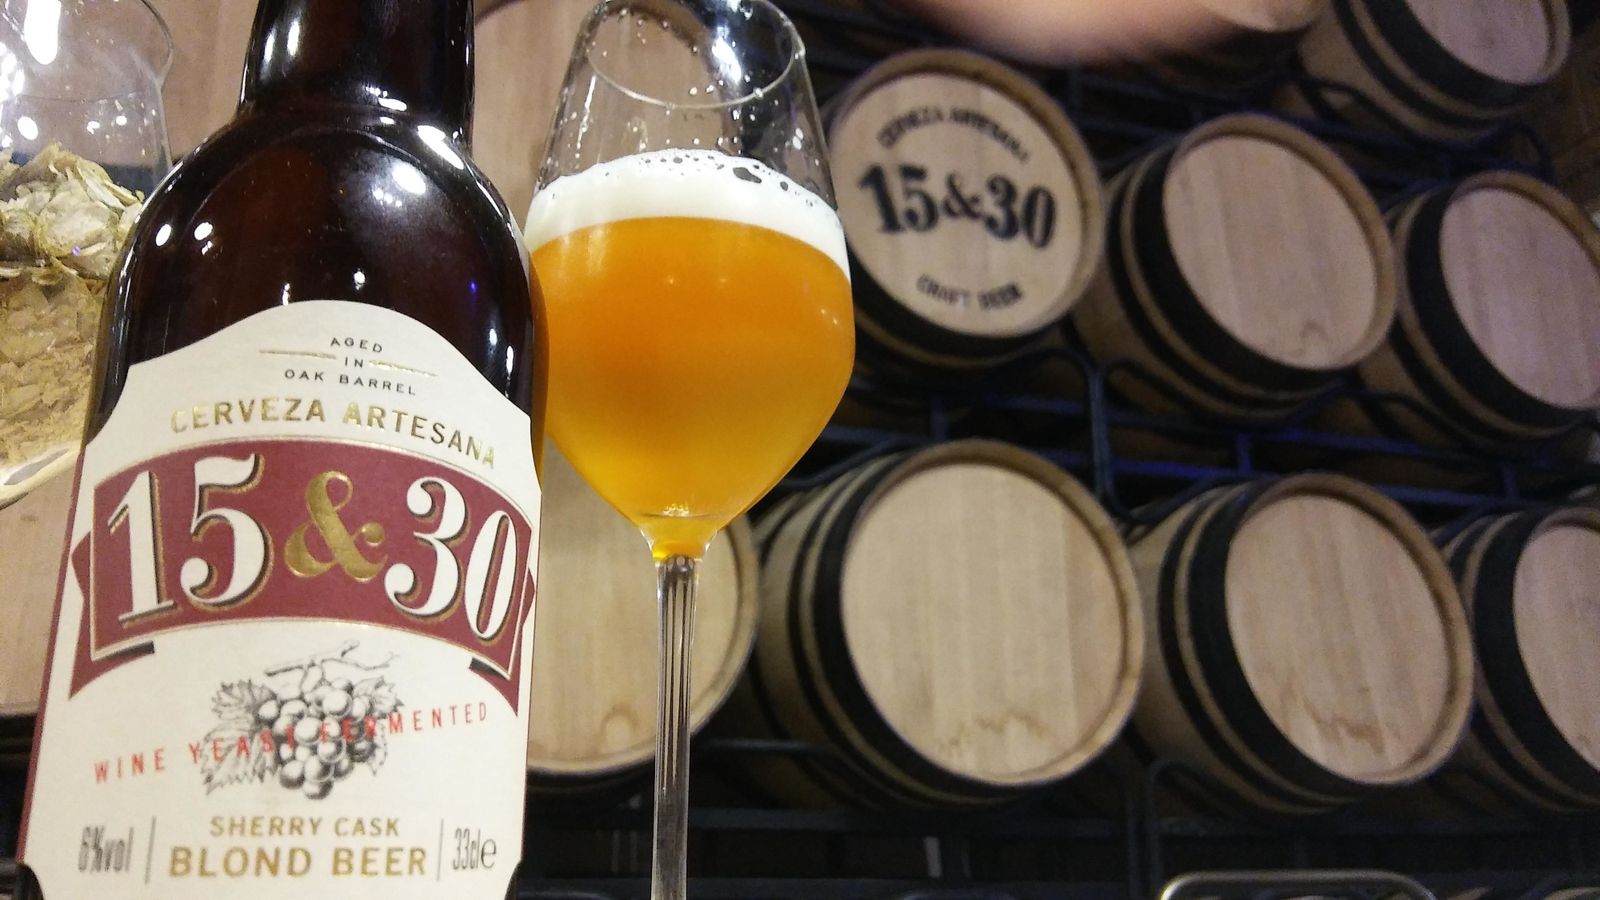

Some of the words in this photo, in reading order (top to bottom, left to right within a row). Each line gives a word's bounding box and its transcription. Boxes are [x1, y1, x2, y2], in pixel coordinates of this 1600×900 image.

[858, 164, 1056, 249] 15&30
[330, 336, 384, 354] AGED
[344, 357, 364, 369] IN
[284, 369, 325, 382] OAK
[339, 374, 417, 396] BARREL
[170, 398, 327, 435] CERVEZA
[342, 402, 497, 470] ARTESANA
[107, 453, 520, 642] 15&30
[94, 748, 166, 783] WINE
[320, 702, 488, 743] FERMENTED
[210, 816, 323, 838] SHERRY
[334, 816, 400, 837] CASK
[169, 847, 312, 878] BLOND
[331, 847, 427, 877] BEER
